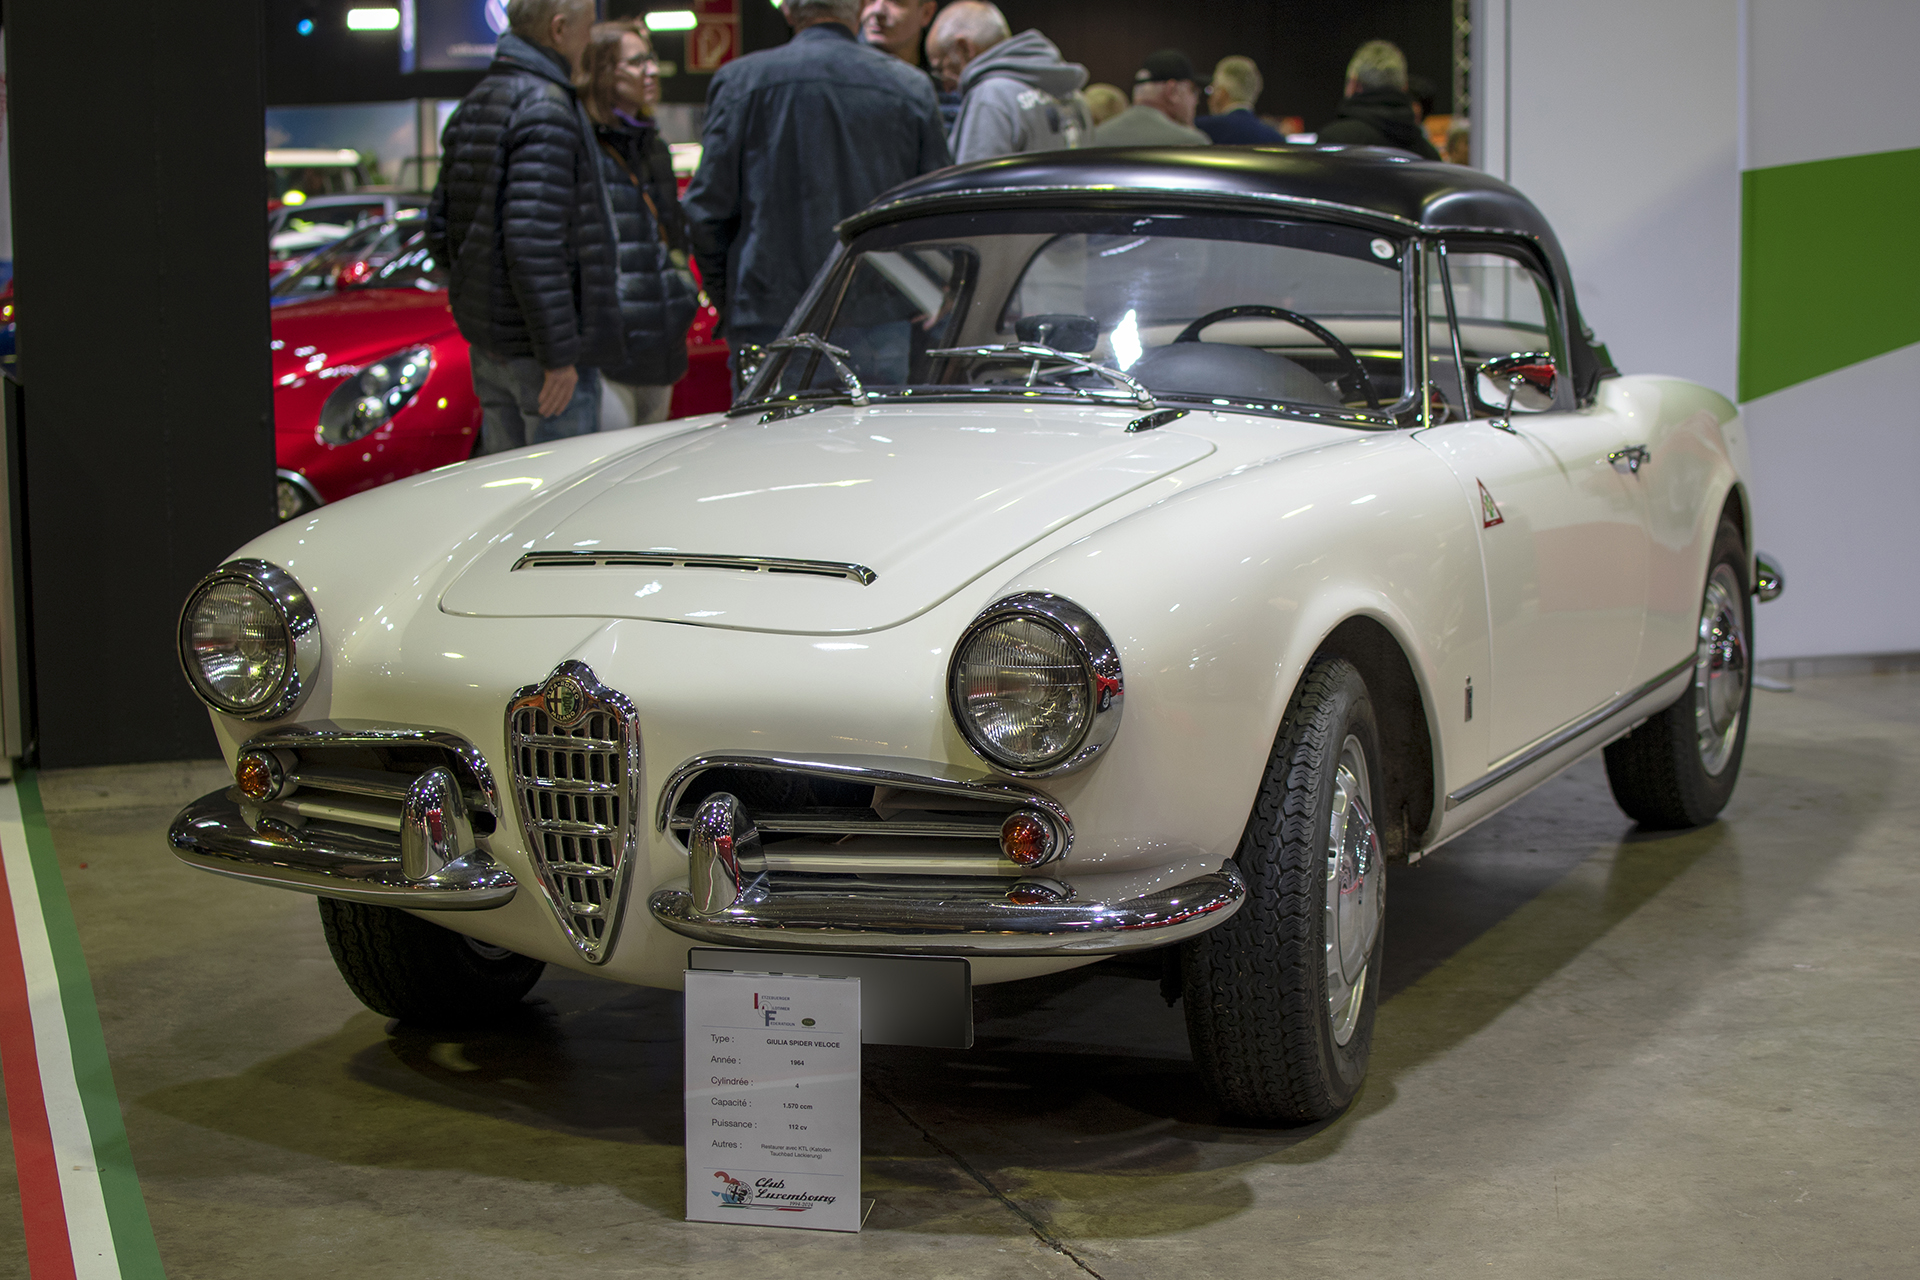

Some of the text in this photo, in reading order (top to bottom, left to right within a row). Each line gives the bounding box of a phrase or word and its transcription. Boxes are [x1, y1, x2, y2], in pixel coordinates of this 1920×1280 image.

[551, 711, 576, 720] MILANO
[711, 1034, 729, 1043] Type
[814, 1041, 841, 1049] VELOCE
[711, 1056, 736, 1064] Année
[711, 1076, 749, 1086] Cylindrée
[711, 1097, 747, 1107] Capacité
[712, 1119, 752, 1128] Puissance
[712, 1140, 737, 1148] Autres
[755, 1177, 785, 1188] Club
[755, 1187, 837, 1204] Luxembourg
